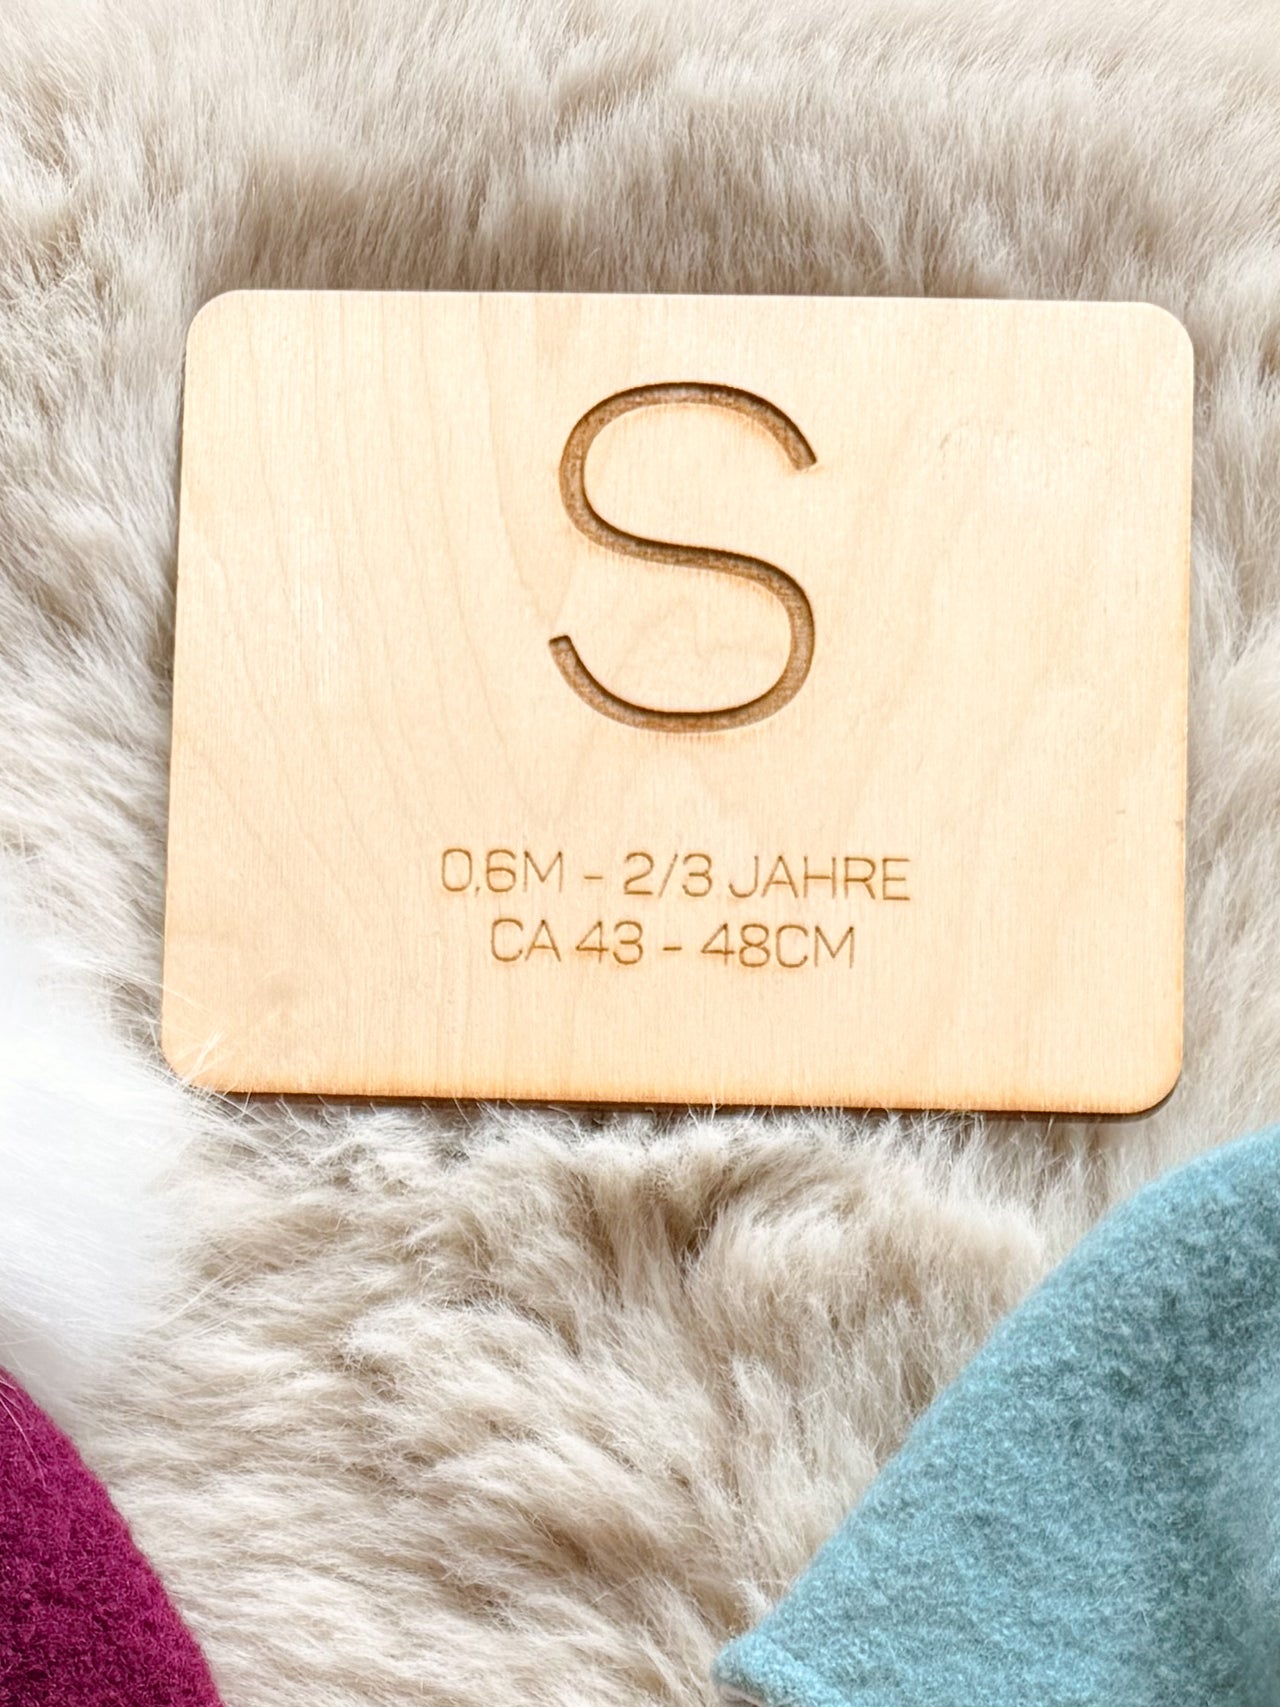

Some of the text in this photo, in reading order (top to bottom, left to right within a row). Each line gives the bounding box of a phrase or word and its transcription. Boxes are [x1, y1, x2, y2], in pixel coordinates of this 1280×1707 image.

[548, 381, 818, 735] S
[623, 851, 714, 898] 2/3
[728, 854, 912, 901] JAHRE
[490, 917, 562, 963] CA
[576, 920, 645, 966] 43
[700, 922, 856, 970] 48CM
